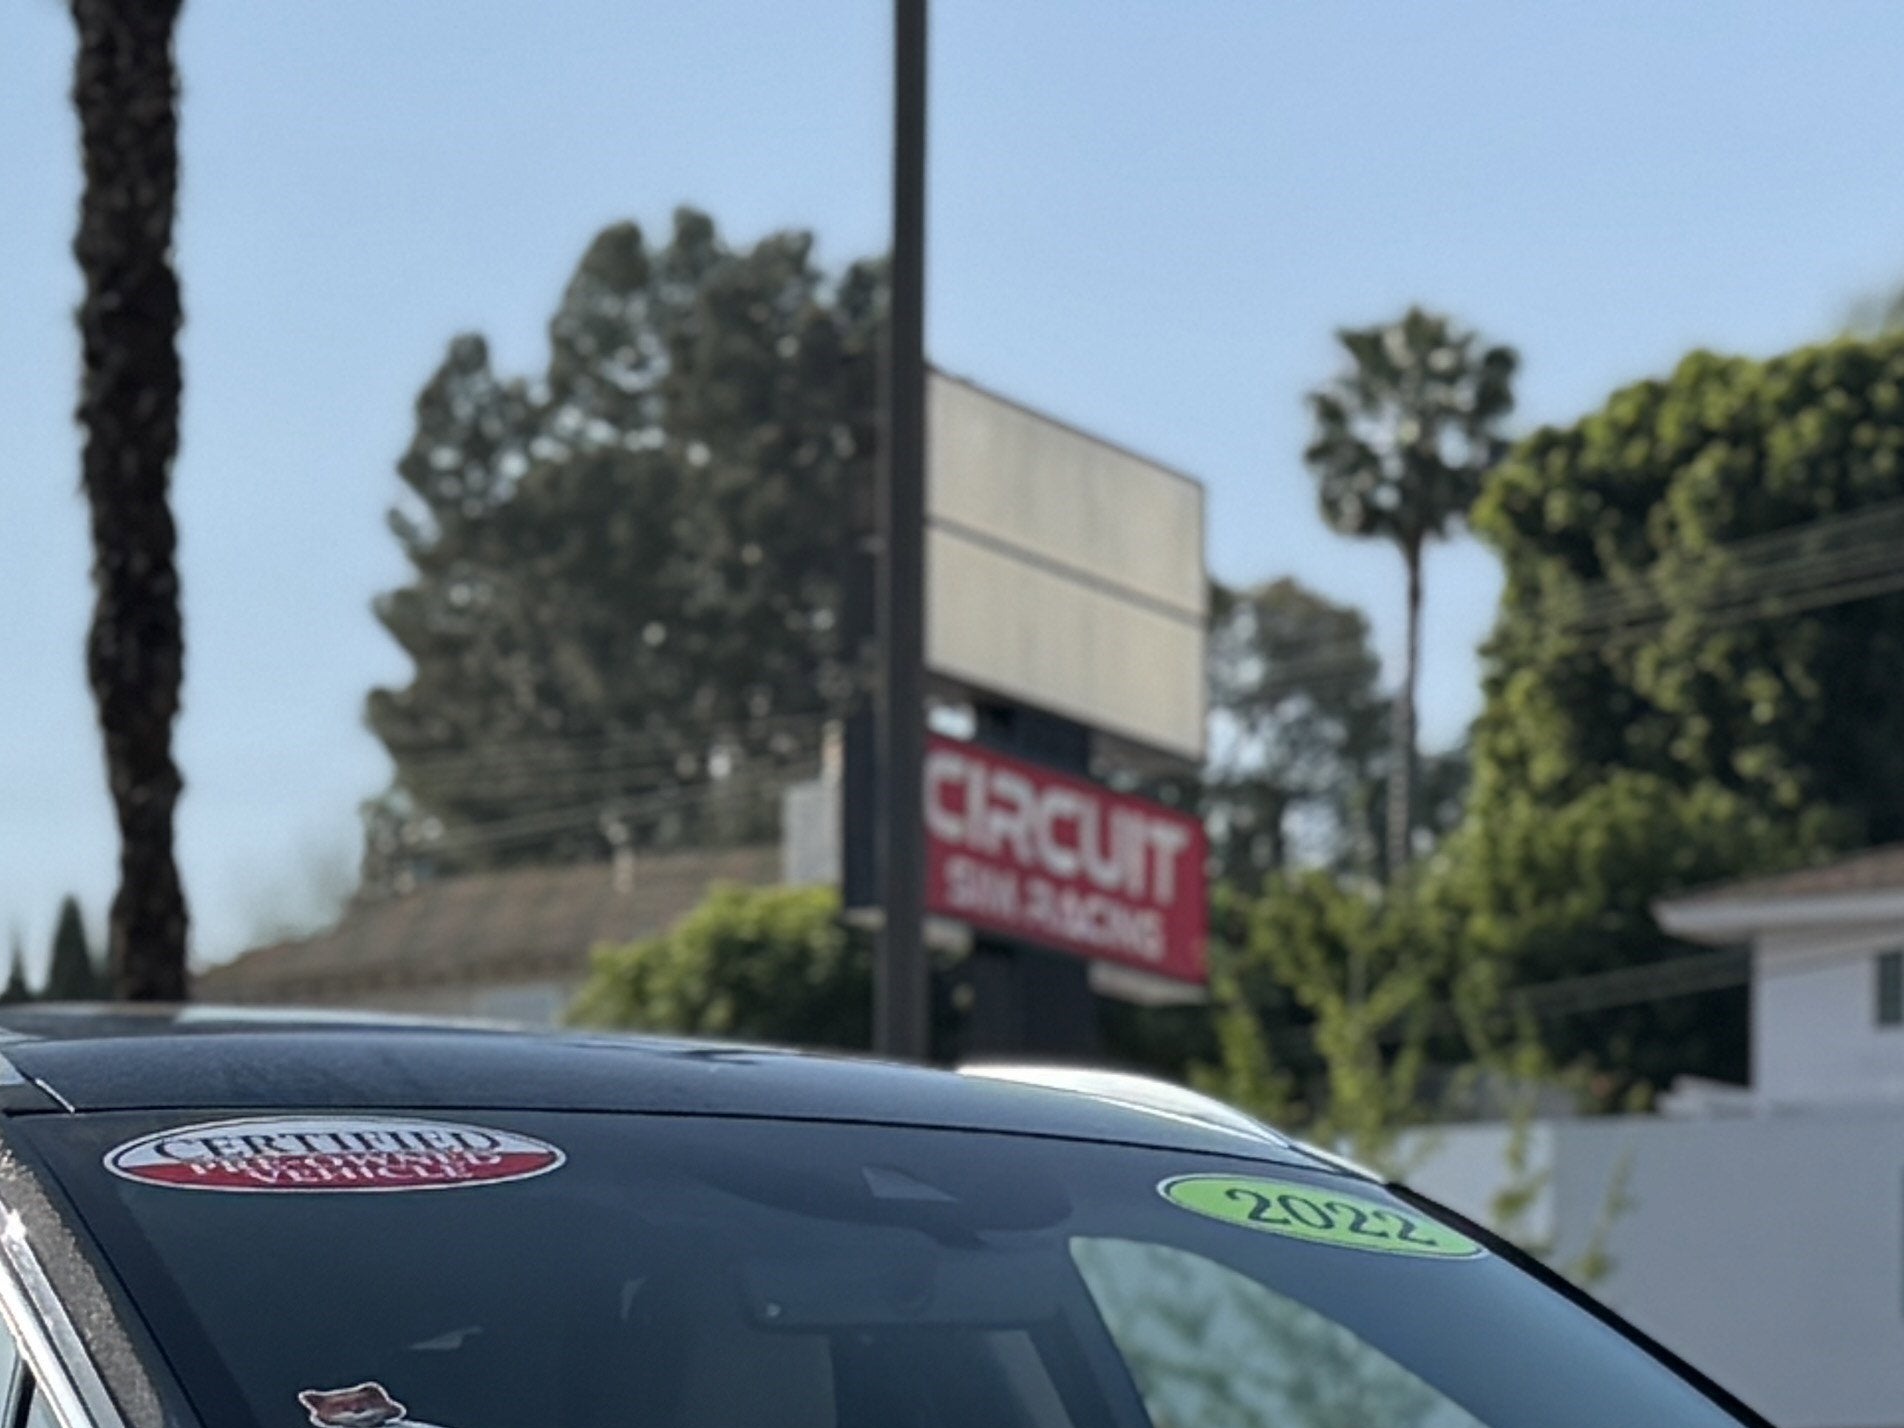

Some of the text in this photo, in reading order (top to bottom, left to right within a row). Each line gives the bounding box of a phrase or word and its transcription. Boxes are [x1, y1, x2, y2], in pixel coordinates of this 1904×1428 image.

[924, 748, 1190, 902] CIRCUIT
[155, 1130, 501, 1163] CERTIFIED
[245, 1156, 474, 1183] VEHICLE
[1224, 1187, 1438, 1247] 2022
